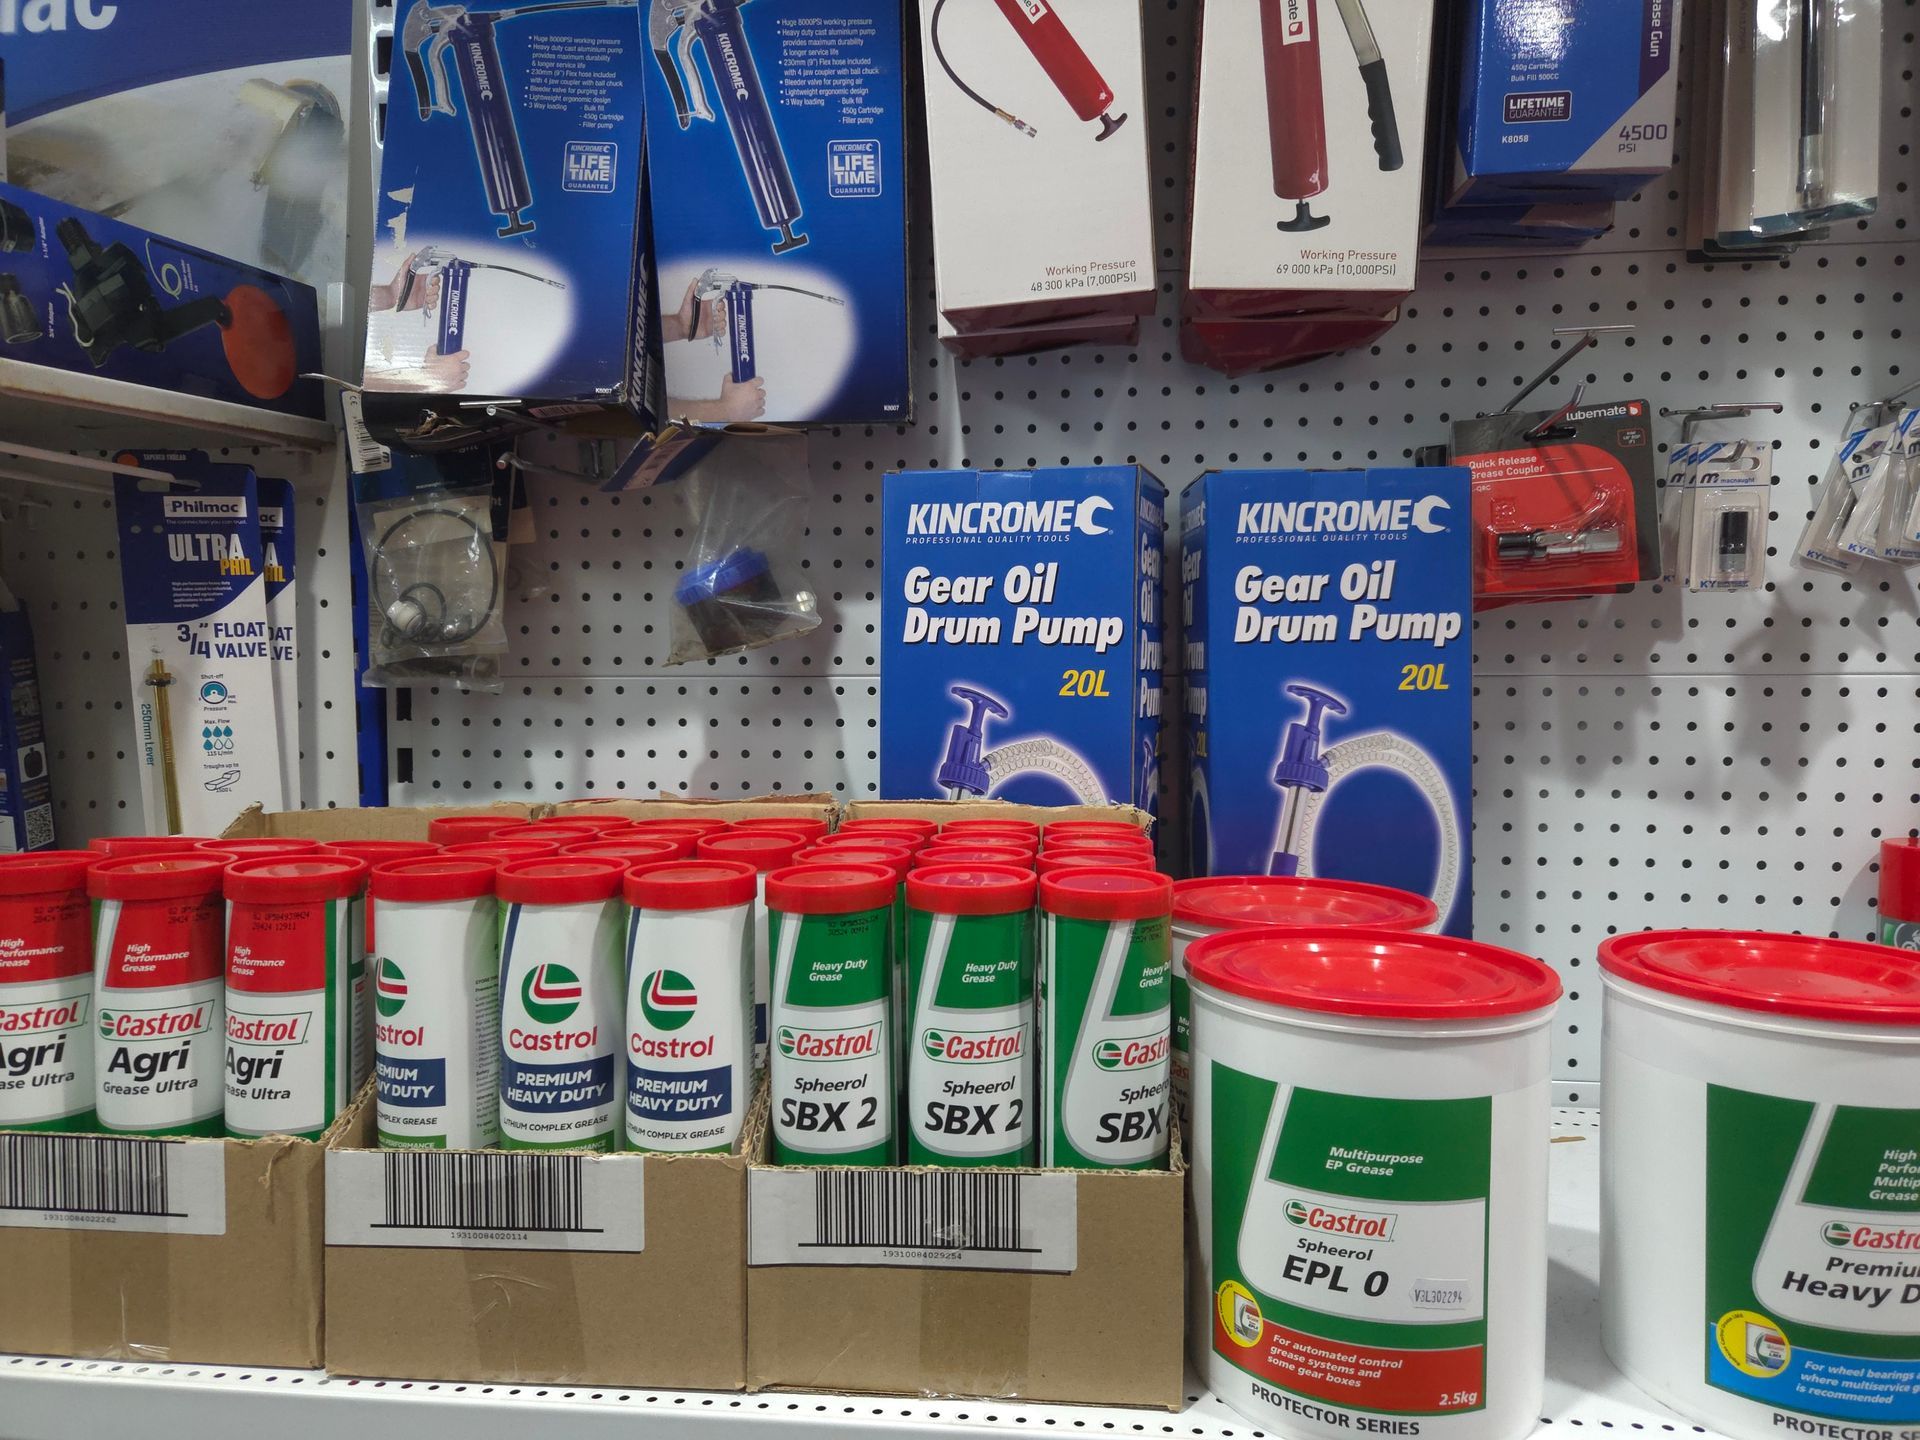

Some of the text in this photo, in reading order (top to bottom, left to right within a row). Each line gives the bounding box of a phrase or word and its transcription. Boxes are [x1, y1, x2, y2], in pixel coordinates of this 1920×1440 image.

[1650, 31, 1662, 57] Gun
[470, 43, 490, 93] KINCROME
[718, 33, 745, 90] KINCROME
[1512, 63, 1558, 72] 450g Cartridge
[1510, 97, 1564, 109] LIFETIME
[1509, 108, 1564, 118] GUARANTEE
[1502, 135, 1528, 143] K8058
[1619, 124, 1667, 141] 4500
[1618, 144, 1636, 152] PSI
[570, 155, 610, 168] LIFE
[834, 155, 874, 170] LIFE
[569, 169, 609, 181] TIME
[834, 171, 875, 184] TIME
[1301, 250, 1396, 262] Working Pressure
[1046, 260, 1136, 276] Working Pressure
[1276, 264, 1395, 276] 69 000 kPa (10,000PSI)
[1031, 271, 1136, 291] 48 300 kPa (7,000PSI)
[1566, 405, 1626, 421] lubemate
[1469, 456, 1537, 469] Quick Release
[1471, 465, 1544, 479] Grease Coupler
[172, 501, 238, 513] Philmac
[907, 501, 1074, 534] KINCROME
[1237, 500, 1412, 534] KINCROME
[906, 534, 1070, 544] PROFESSIONAL QUALITY TOOLS
[1236, 535, 1317, 543] PROFESSIONAL
[1322, 534, 1367, 542] QUALITY
[168, 534, 244, 561] ULTRA
[220, 558, 254, 575] PHIL
[904, 562, 1058, 603] Gear Oil
[1235, 560, 1396, 603] Gear Oil
[214, 622, 265, 638] FLOAT
[903, 607, 1123, 652] Drum Pump
[1234, 604, 1460, 647] Drum Pump
[215, 642, 267, 658] VALVE
[1059, 669, 1109, 697] 20L
[1398, 664, 1449, 690] 20L
[142, 704, 154, 765] 250mm Lever
[0, 939, 24, 949] High
[127, 944, 151, 953] High
[234, 946, 251, 955] High
[124, 951, 189, 963] Performance
[233, 957, 285, 967] Performance
[122, 964, 156, 973] Grease
[232, 965, 254, 976] Grease
[812, 959, 868, 973] Heavy Duty
[965, 960, 1017, 974] Heavy Duty
[1143, 966, 1163, 977] Heavy
[809, 973, 843, 982] Grease
[962, 975, 995, 983] Grease
[1140, 977, 1163, 988] Grease
[116, 1008, 203, 1036] Castrol
[228, 1018, 298, 1041] Castrol
[510, 1025, 597, 1051] Castrol
[632, 1033, 714, 1058] Castrol
[797, 1029, 873, 1056] Castrol
[946, 1030, 1020, 1059] Castrol
[108, 1040, 191, 1081] Agri
[225, 1047, 284, 1084] Agri
[32, 1072, 74, 1087] Ultra
[517, 1069, 592, 1086] PREMIUM
[636, 1077, 707, 1094] PREMIUM
[794, 1074, 867, 1092] Spheerol
[943, 1076, 1015, 1095] Spheerol
[104, 1079, 197, 1095] Grease Ultra
[251, 1088, 291, 1099] Ultra
[392, 1085, 435, 1098] DUTY
[508, 1083, 606, 1104] HEAVY DUTY
[630, 1091, 722, 1112] HEAVY DUTY
[781, 1096, 877, 1132] SBX 2
[925, 1099, 1024, 1136] SBX 2
[529, 1115, 608, 1131] COMPLEX GREASE
[1096, 1103, 1164, 1143] SBX
[647, 1126, 725, 1139] COMPLEX GREASE
[1330, 1147, 1423, 1164] Multipurpose
[1884, 1150, 1916, 1162] High
[1326, 1160, 1393, 1176] EP Grease
[1869, 1190, 1918, 1201] Grease
[1309, 1208, 1387, 1237] Castrol
[451, 1232, 527, 1240] 19310084020114
[1297, 1238, 1373, 1260] Spheerol
[1283, 1255, 1348, 1292] EPL
[1782, 1270, 1892, 1308] Heavy
[1273, 1335, 1403, 1369] For automated control
[1270, 1345, 1381, 1379] grease systems and
[1268, 1356, 1361, 1388] some gear boxes
[1805, 1361, 1914, 1381] For wheel bearings
[1801, 1374, 1910, 1392] where multiservice
[1439, 1391, 1477, 1406] 2.5kg
[1796, 1384, 1893, 1404] is recommended
[1252, 1383, 1420, 1435] PROTECTOR SERIES
[1773, 1413, 1893, 1440] PROTECTOR
